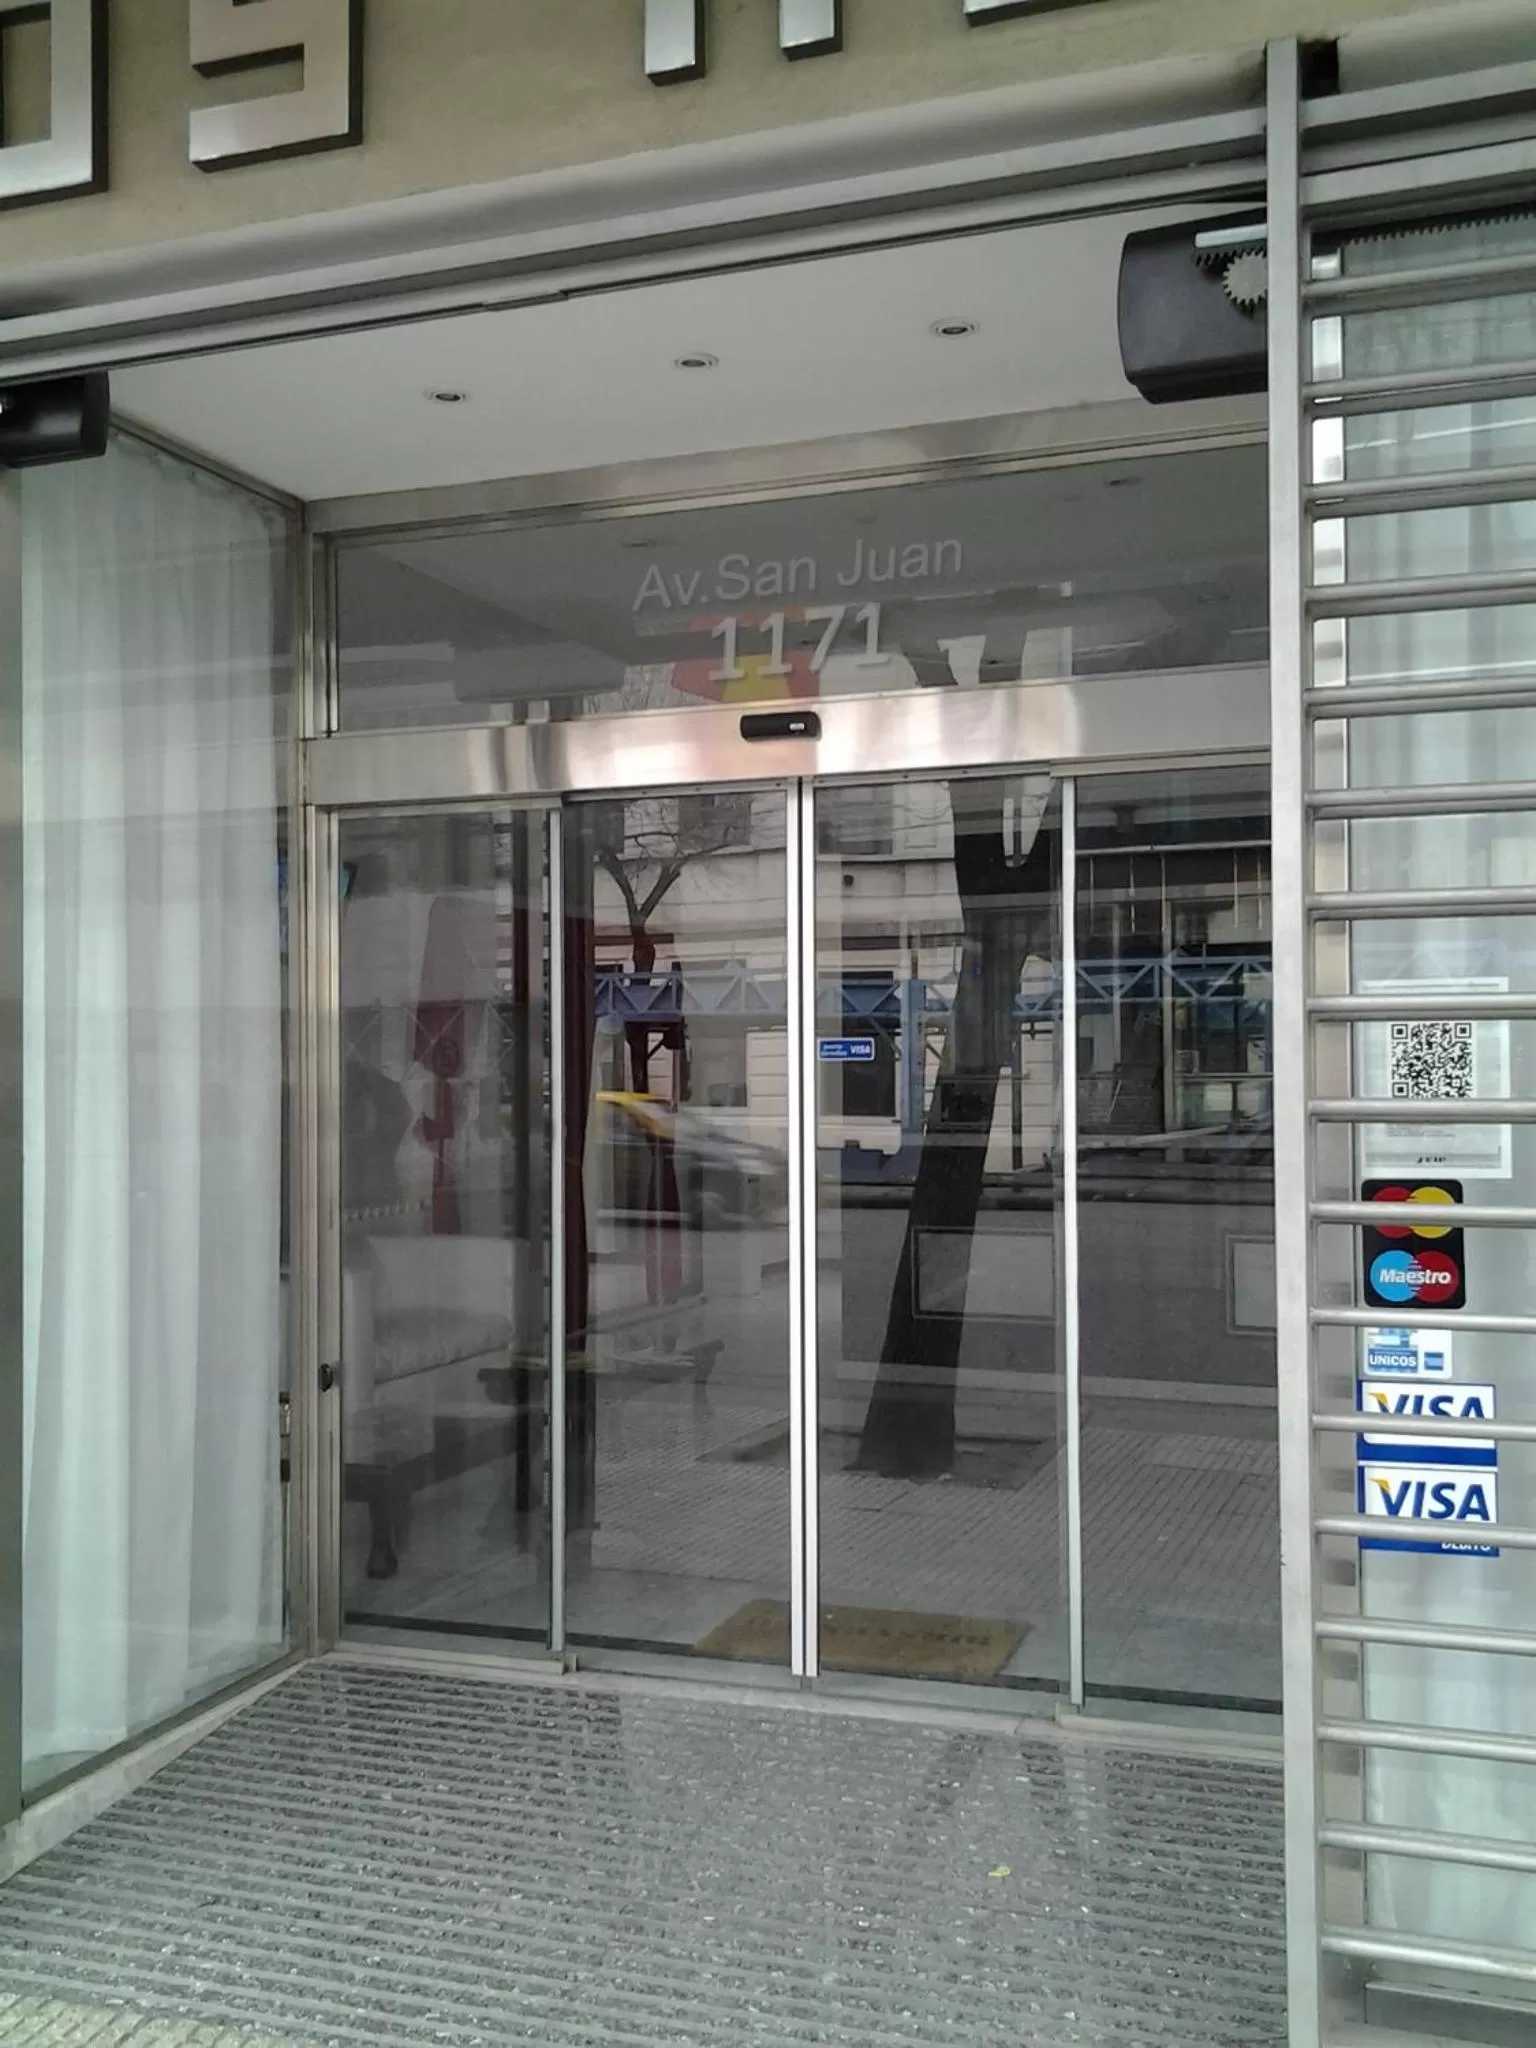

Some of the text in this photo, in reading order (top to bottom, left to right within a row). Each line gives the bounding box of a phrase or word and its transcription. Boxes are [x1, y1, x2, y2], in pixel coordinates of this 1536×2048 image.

[836, 538, 963, 587] Juan
[707, 601, 890, 682] 1171
[1379, 1268, 1452, 1285] Maestro
[1369, 1355, 1417, 1368] UNICOS
[1369, 1477, 1490, 1522] VISA
